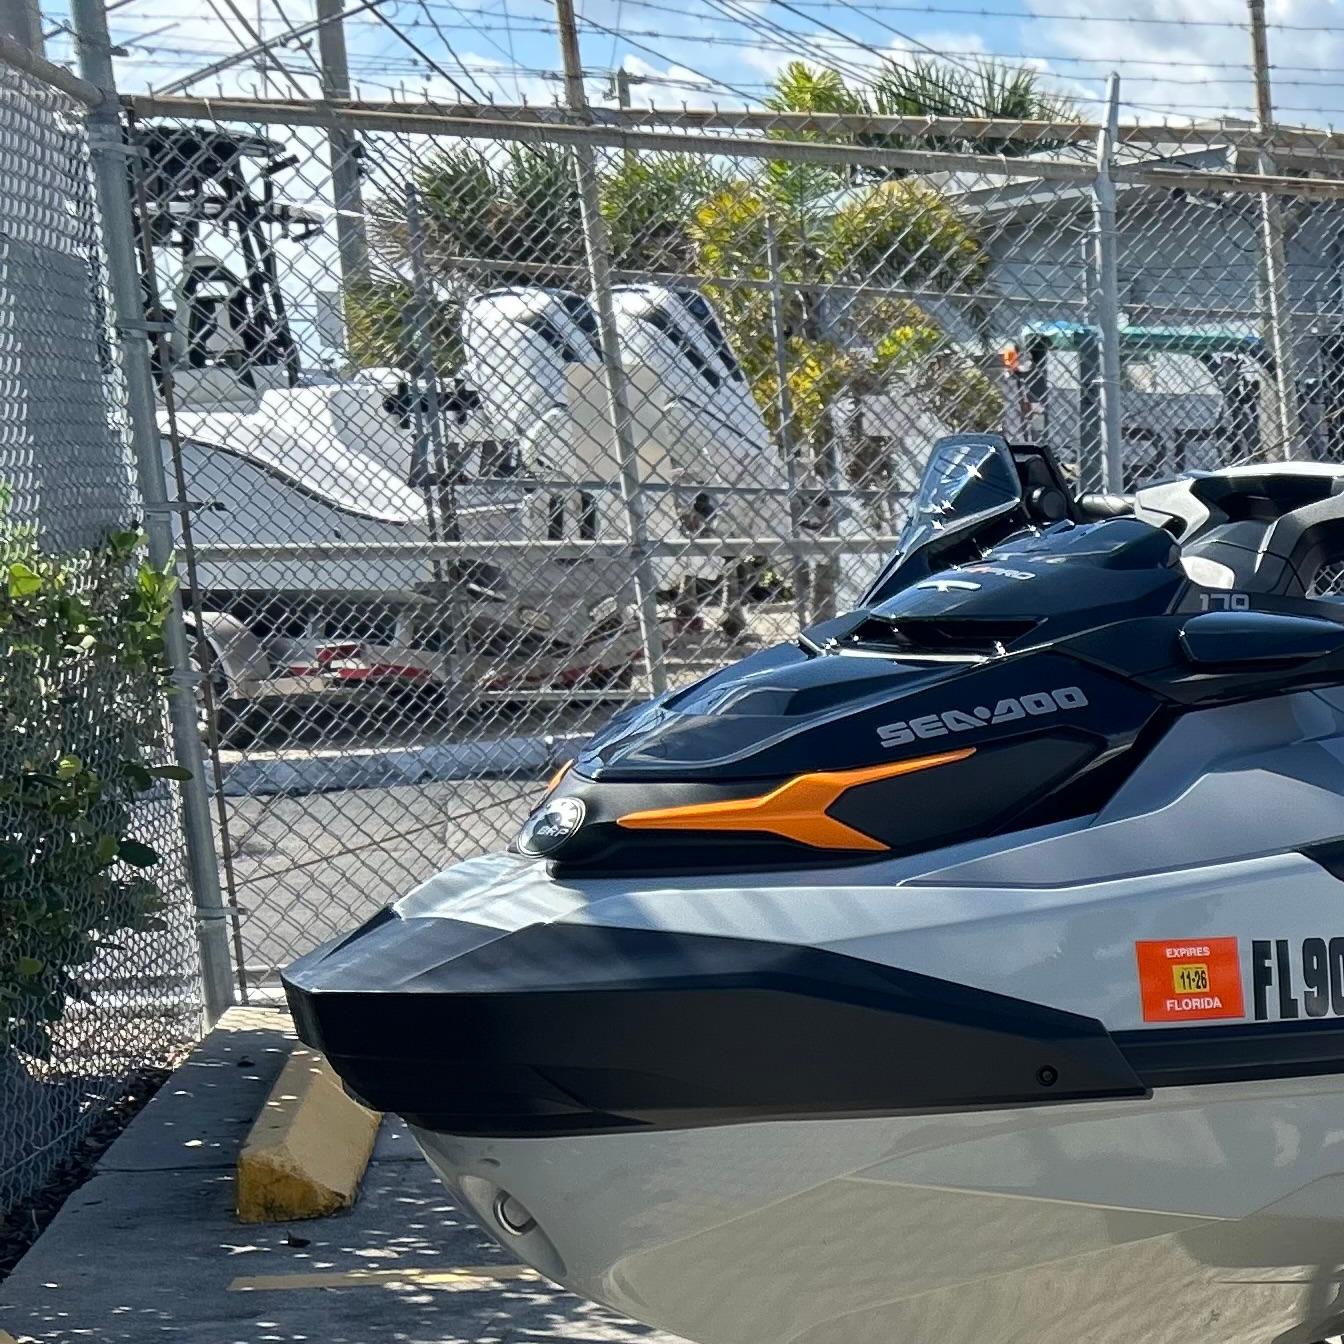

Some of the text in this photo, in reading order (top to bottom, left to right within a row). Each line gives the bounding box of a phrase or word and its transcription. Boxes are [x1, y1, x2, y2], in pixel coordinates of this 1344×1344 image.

[1200, 593, 1250, 611] 170
[1166, 946, 1211, 959] EXPIRES
[1166, 996, 1223, 1011] FLORIDA
